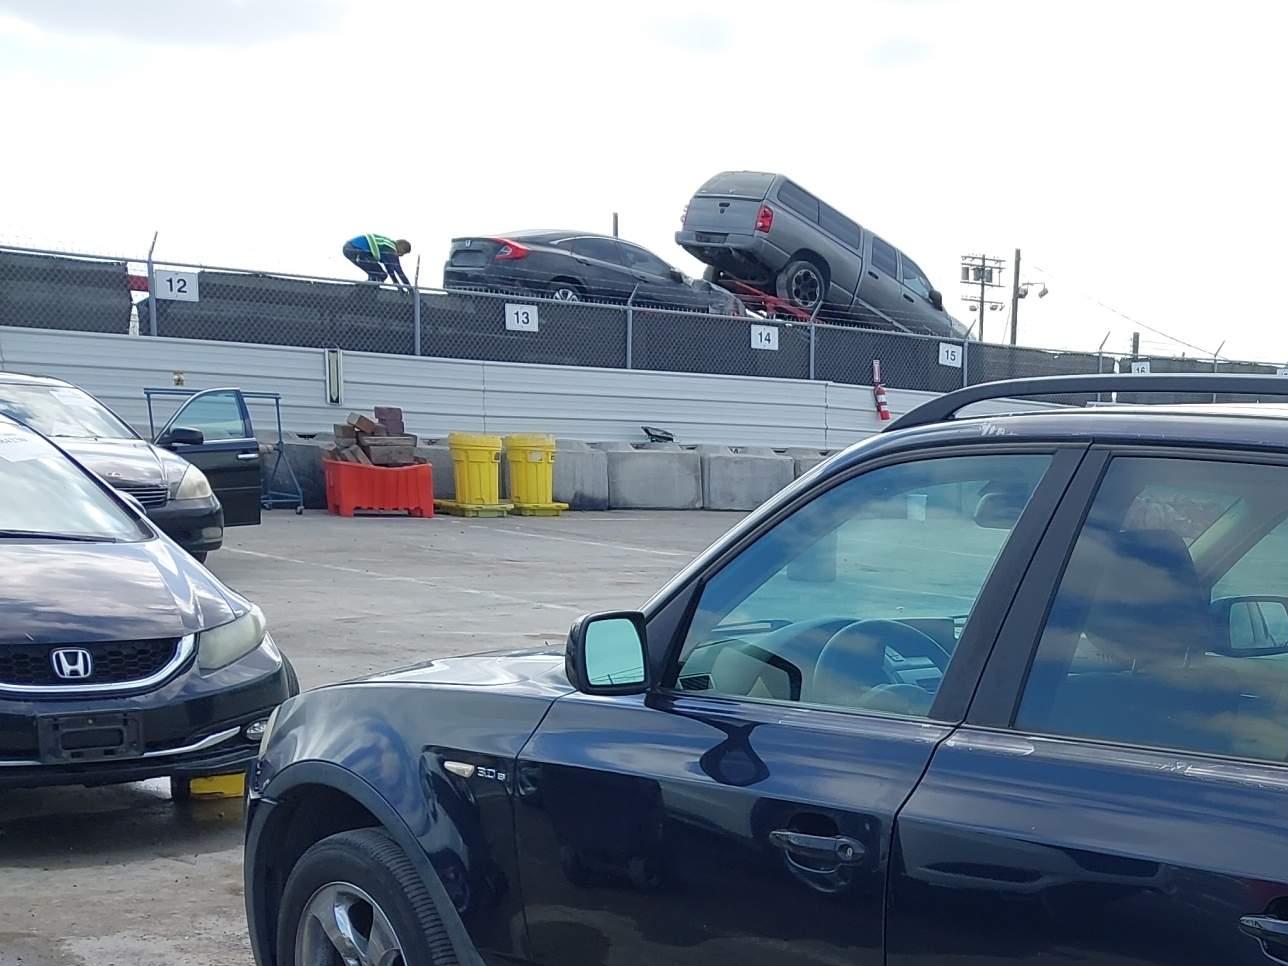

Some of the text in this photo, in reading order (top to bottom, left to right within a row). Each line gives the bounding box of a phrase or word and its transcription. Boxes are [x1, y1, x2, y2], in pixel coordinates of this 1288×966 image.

[166, 277, 188, 293] 12
[513, 310, 530, 325] 13
[757, 331, 771, 344] 14
[944, 349, 957, 362] 15
